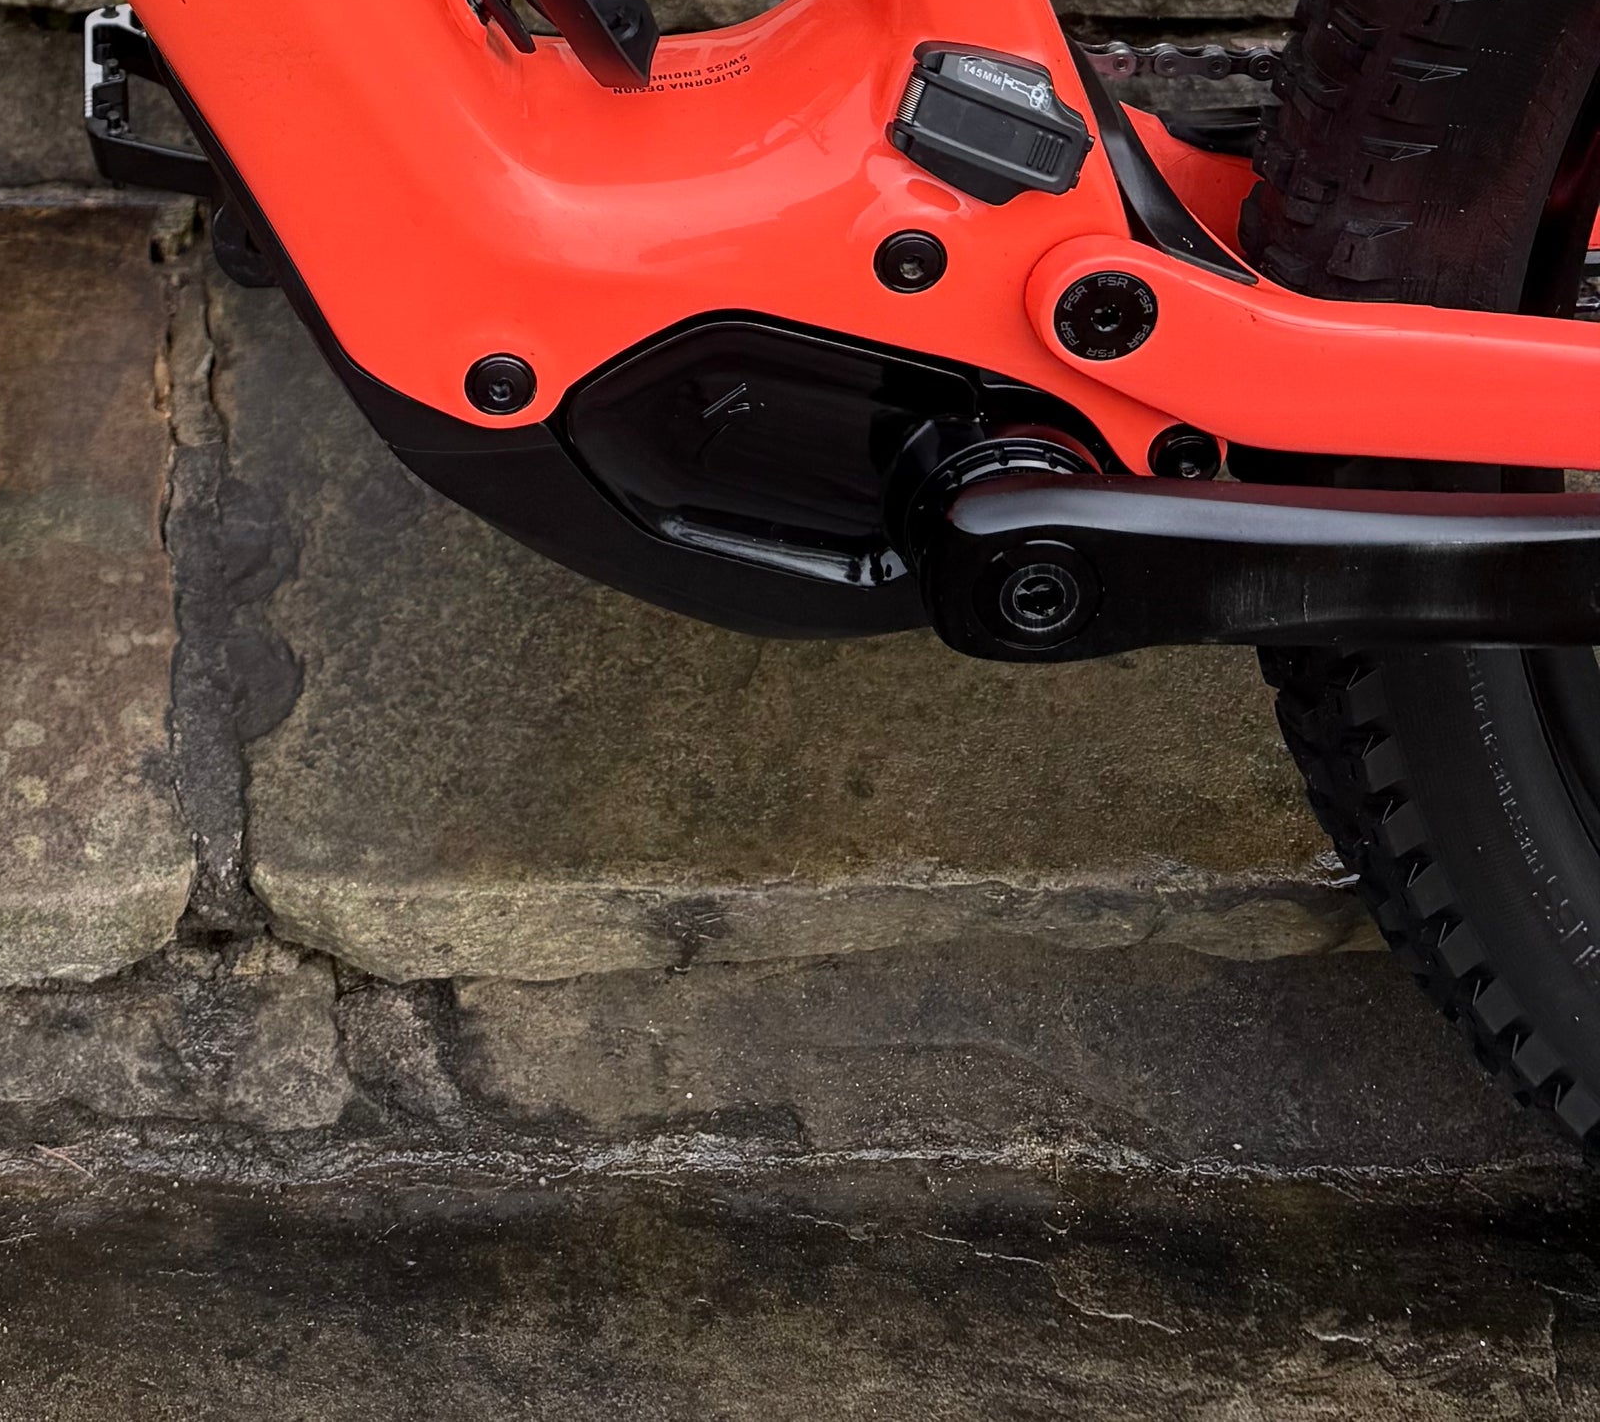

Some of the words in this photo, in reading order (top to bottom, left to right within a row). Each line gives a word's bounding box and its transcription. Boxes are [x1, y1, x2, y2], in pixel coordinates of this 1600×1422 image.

[706, 53, 748, 74] SWISS
[963, 63, 1003, 85] 145MM
[670, 64, 751, 90] CALIFORNIA
[613, 85, 665, 95] DESIGN
[1097, 276, 1128, 289] FSR
[1063, 285, 1089, 311] FSR
[1134, 288, 1153, 314] FSR
[1060, 321, 1080, 347] FSR
[1126, 324, 1151, 349] FSR
[1086, 347, 1116, 358] FSR
